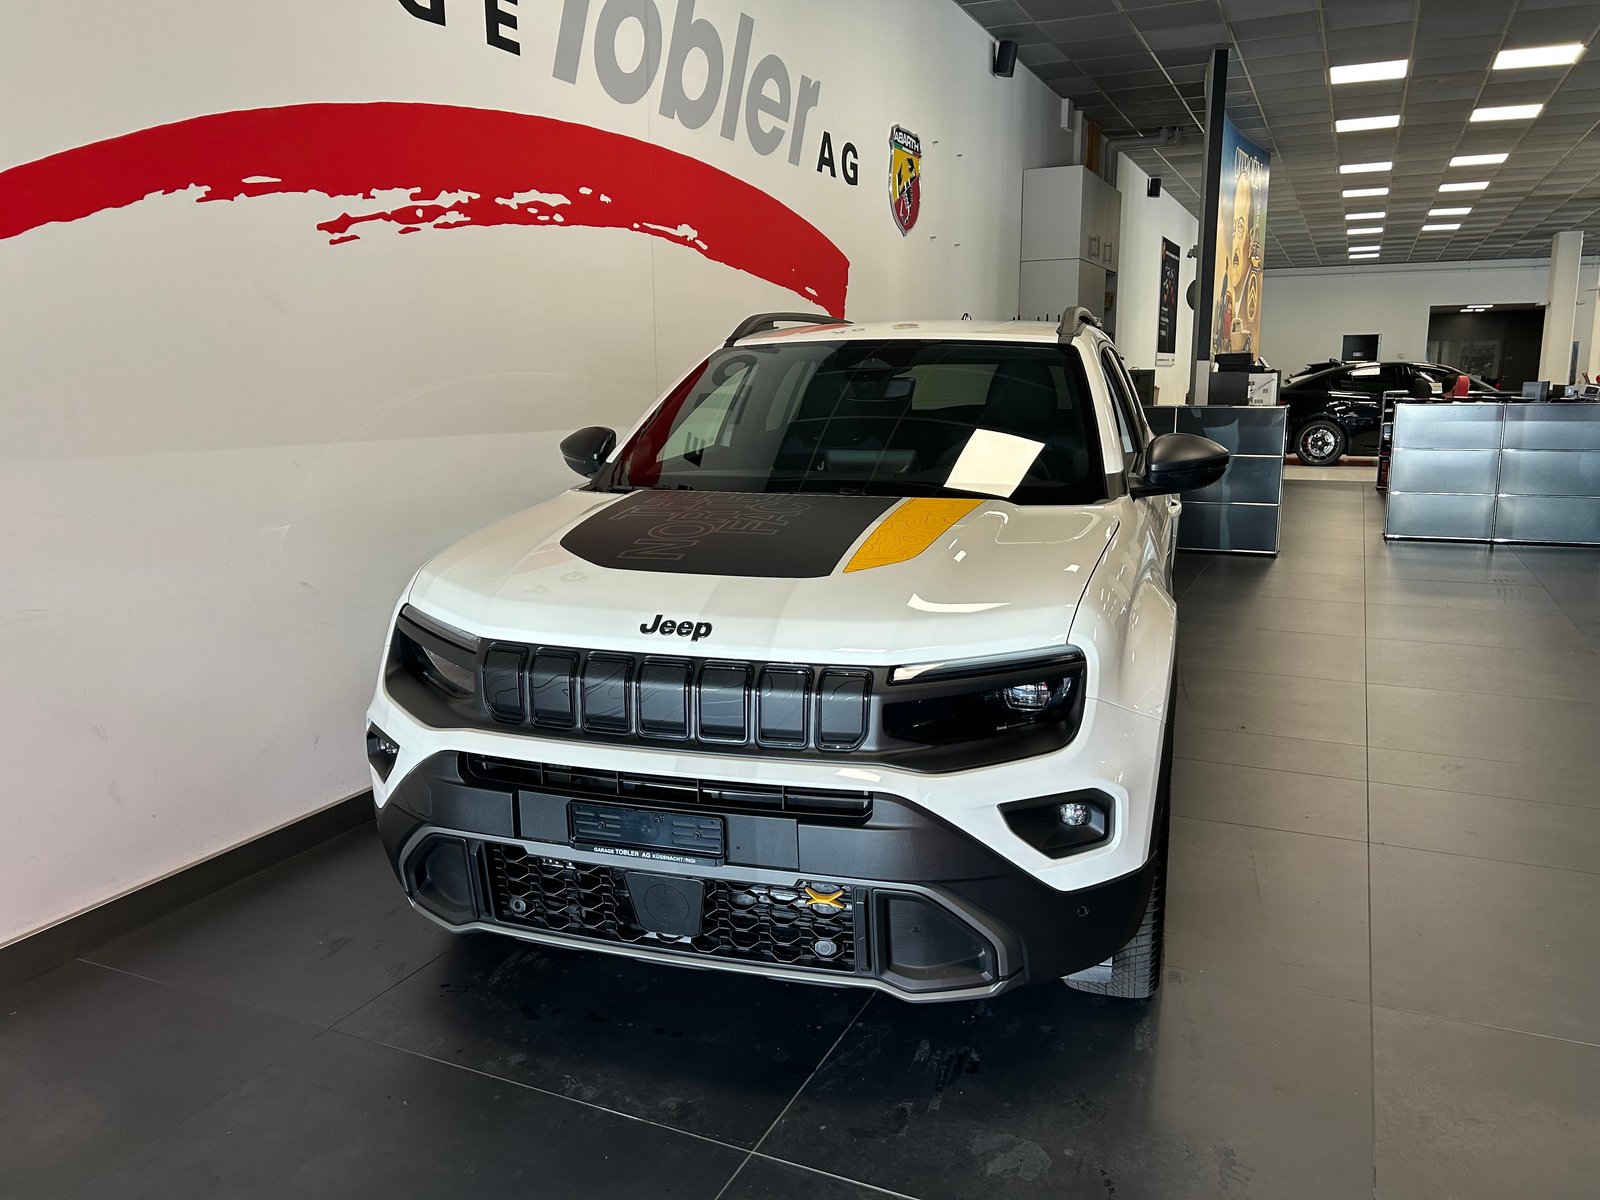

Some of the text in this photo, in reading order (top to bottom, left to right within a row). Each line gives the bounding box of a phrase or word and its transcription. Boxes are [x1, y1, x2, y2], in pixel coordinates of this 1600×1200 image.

[894, 131, 920, 153] ABARTH
[816, 130, 859, 186] AG
[640, 614, 713, 642] Jeep
[593, 846, 615, 855] GARAGE
[615, 848, 640, 857] TOBLER
